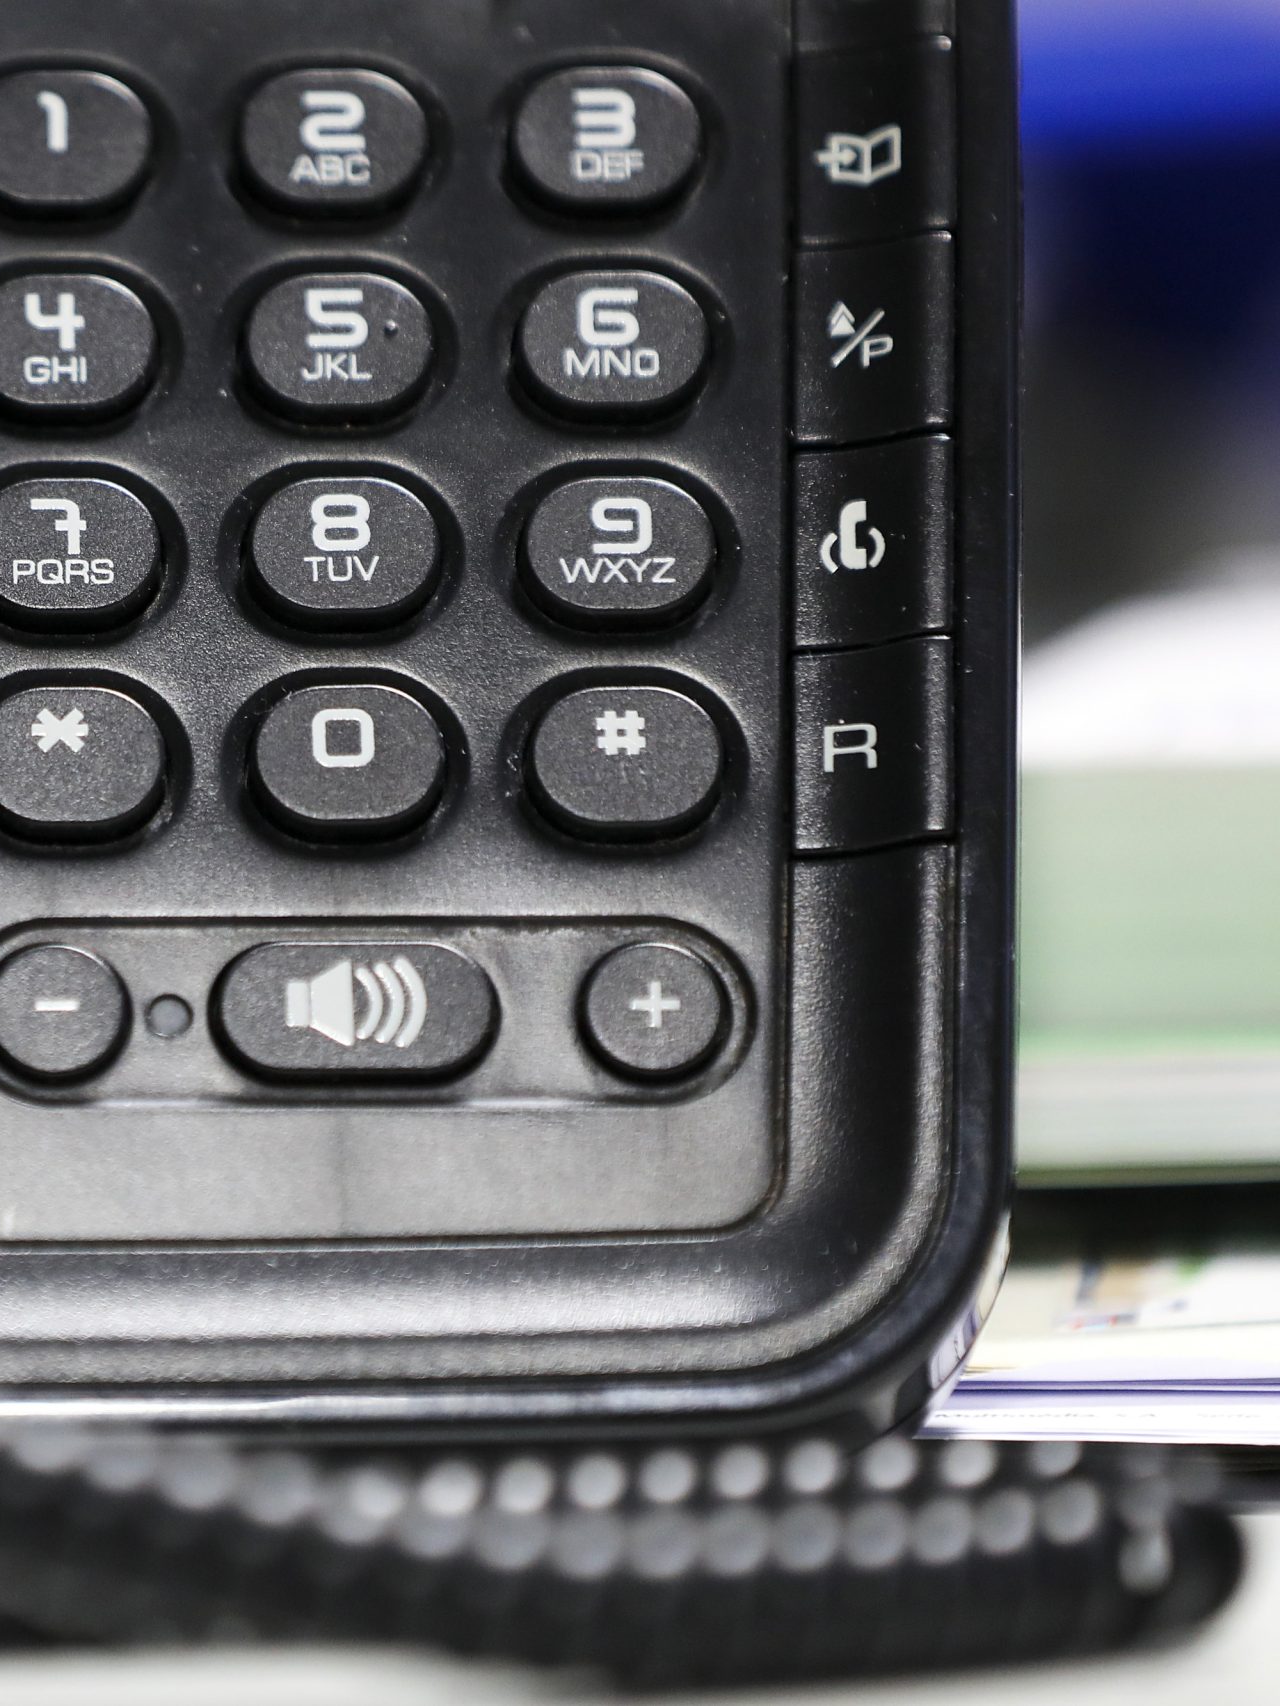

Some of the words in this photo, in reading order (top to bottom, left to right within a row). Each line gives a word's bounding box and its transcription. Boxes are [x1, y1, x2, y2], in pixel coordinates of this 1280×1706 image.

[38, 91, 68, 152] 1
[301, 91, 366, 153] 2
[574, 88, 636, 151] 3
[290, 152, 370, 185] ABC
[573, 148, 644, 181] DEF
[24, 292, 86, 351] 4
[305, 288, 369, 349] 5
[577, 287, 640, 348] 6
[23, 356, 88, 385] GHI
[301, 352, 373, 382] JKL
[563, 348, 660, 378] MNO
[29, 497, 87, 556] 7
[310, 493, 371, 552] 8
[590, 496, 653, 555] 9
[12, 558, 115, 585] PQRS
[303, 555, 380, 582] TUV
[559, 556, 677, 584] WXYZ
[310, 707, 376, 768] 0
[823, 722, 878, 772] R
